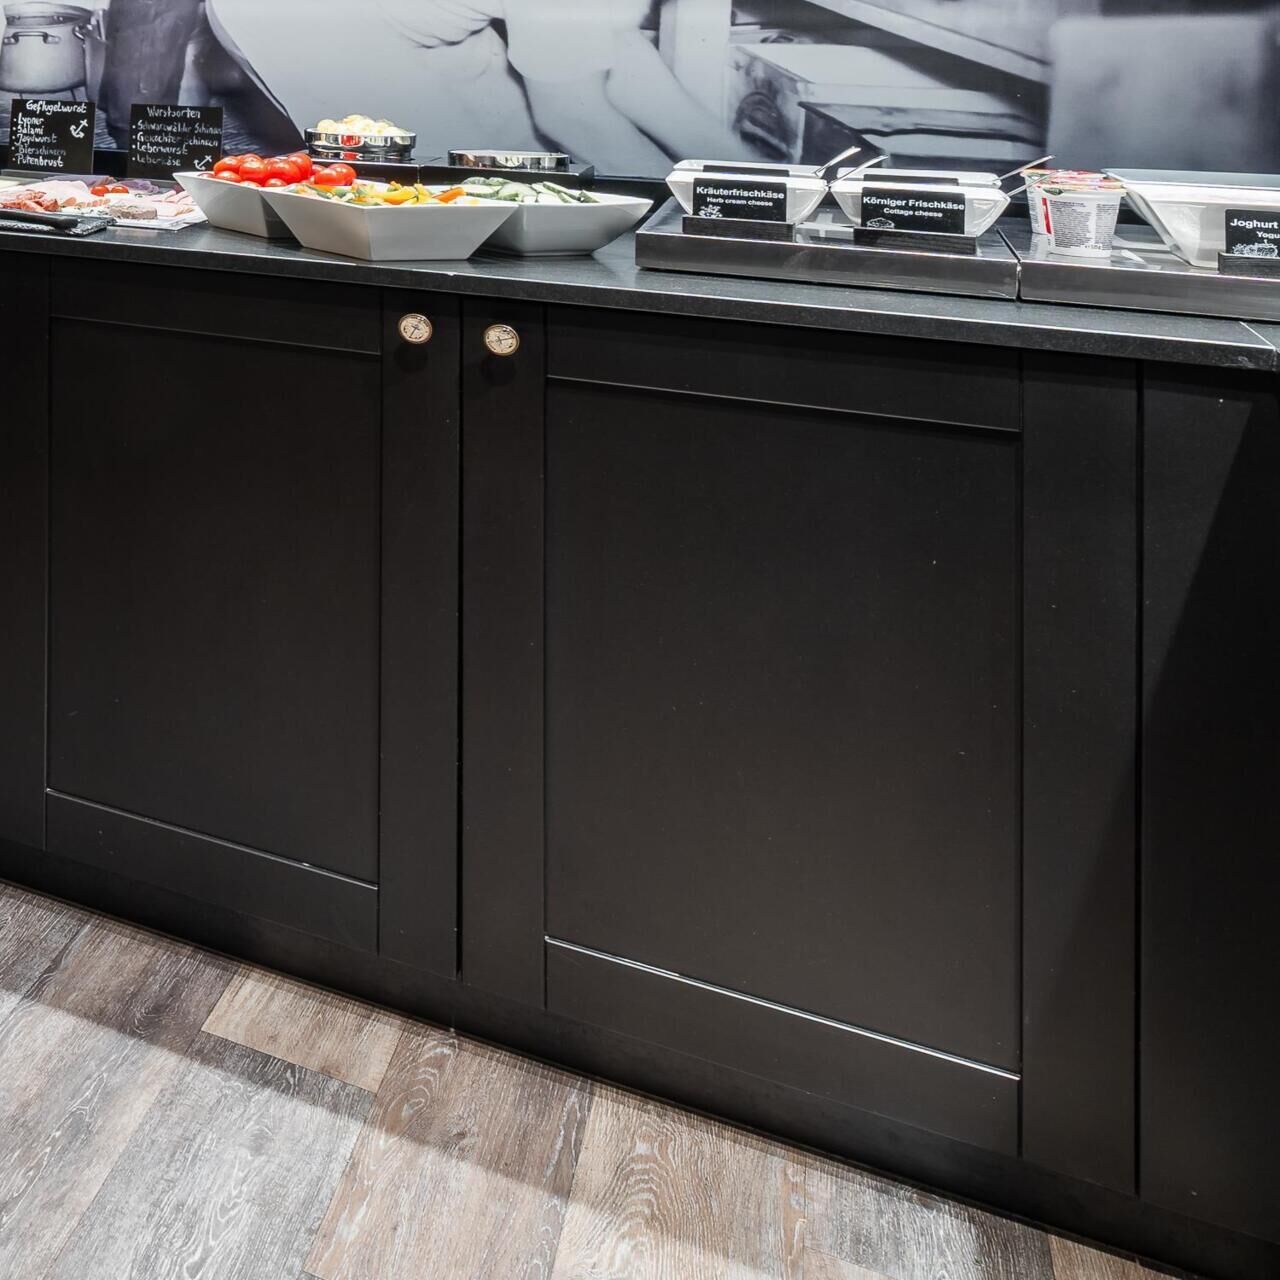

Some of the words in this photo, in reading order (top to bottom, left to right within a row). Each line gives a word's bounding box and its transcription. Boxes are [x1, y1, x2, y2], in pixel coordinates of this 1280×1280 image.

[18, 112, 44, 127] Lyoner
[17, 125, 44, 135] Salami
[137, 142, 188, 155] Leberwurst
[15, 153, 64, 168] Putenbrust
[696, 186, 785, 199] Kräuterfrischkäse
[748, 199, 773, 207] cheese
[863, 195, 906, 208] Körniger
[908, 199, 965, 210] Frischkäse
[883, 207, 914, 216] Cottage
[915, 209, 943, 218] cheese
[1230, 218, 1279, 229] Joghurt
